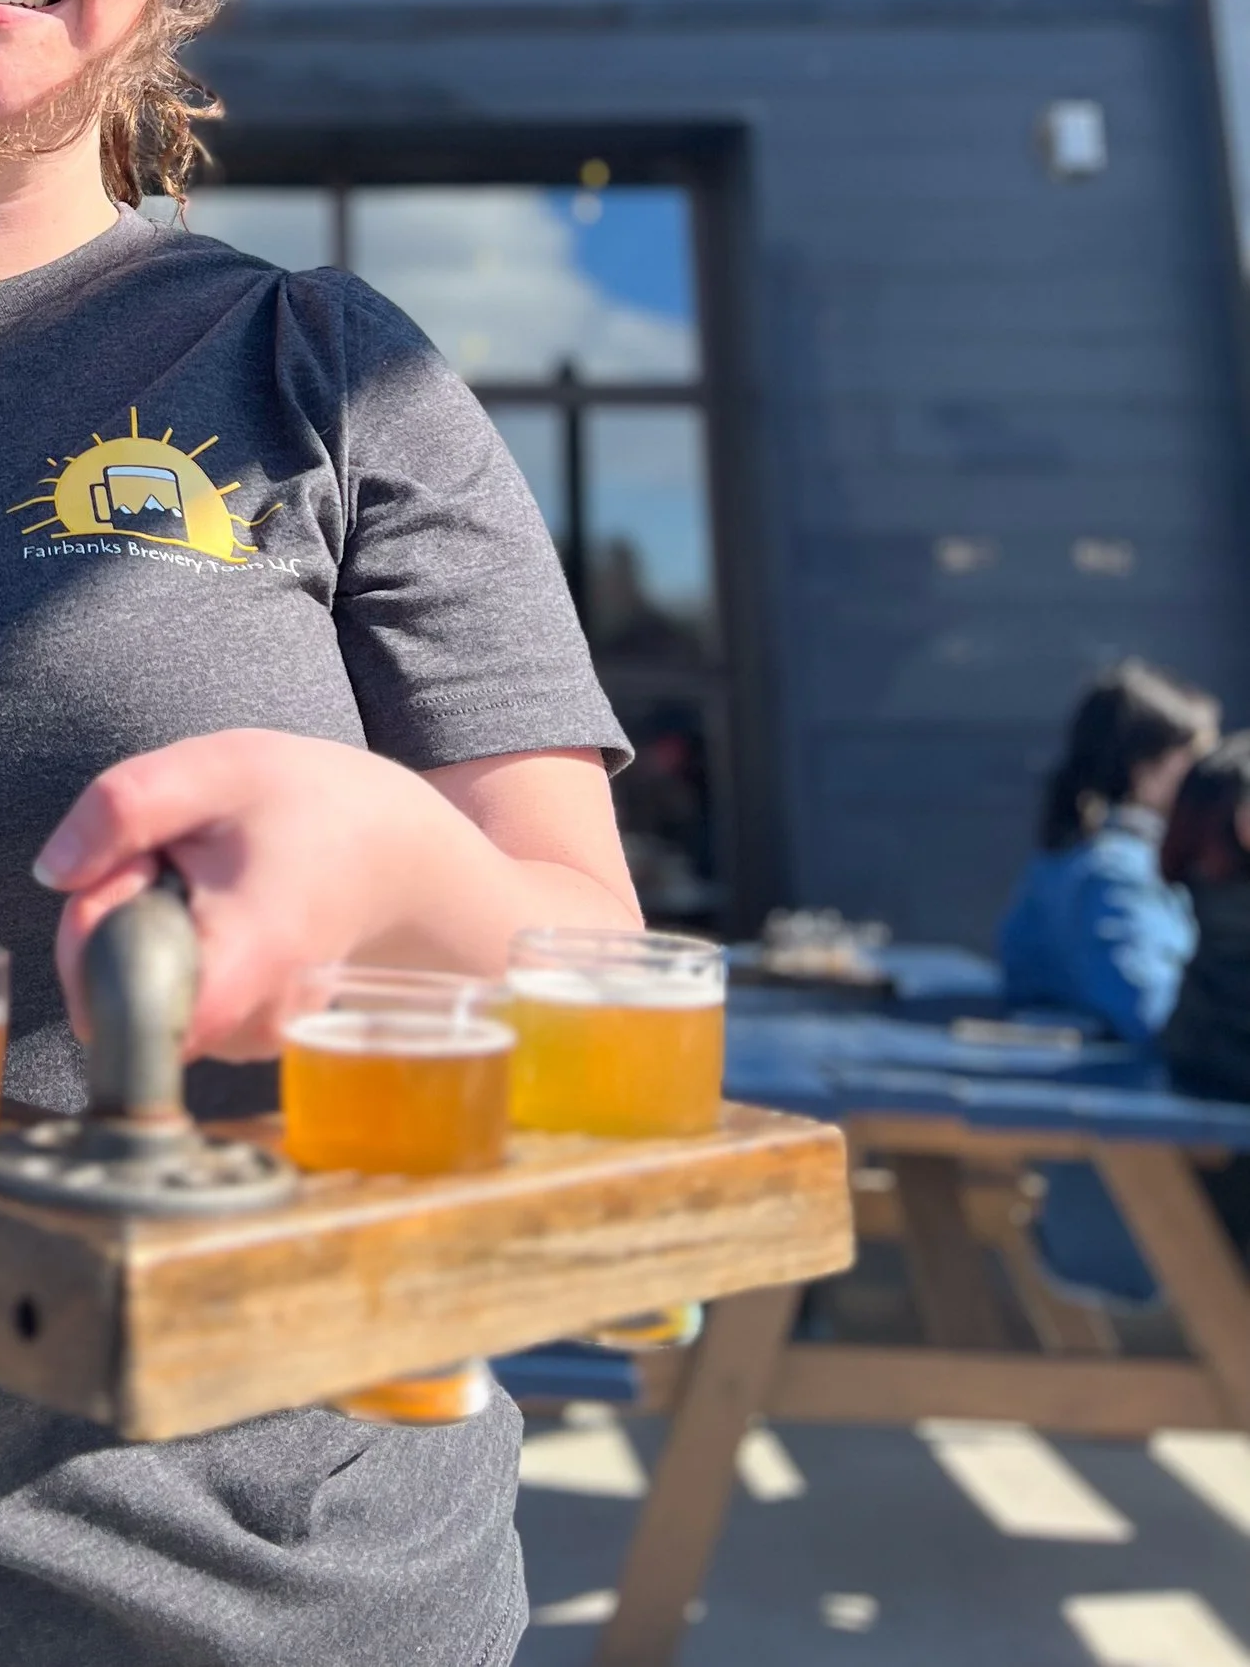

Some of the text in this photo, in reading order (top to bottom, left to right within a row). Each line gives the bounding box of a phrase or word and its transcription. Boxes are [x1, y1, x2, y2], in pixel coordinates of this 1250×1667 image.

[23, 537, 122, 560] Fairbanks
[128, 540, 202, 574] Brewery
[206, 558, 265, 574] Tours
